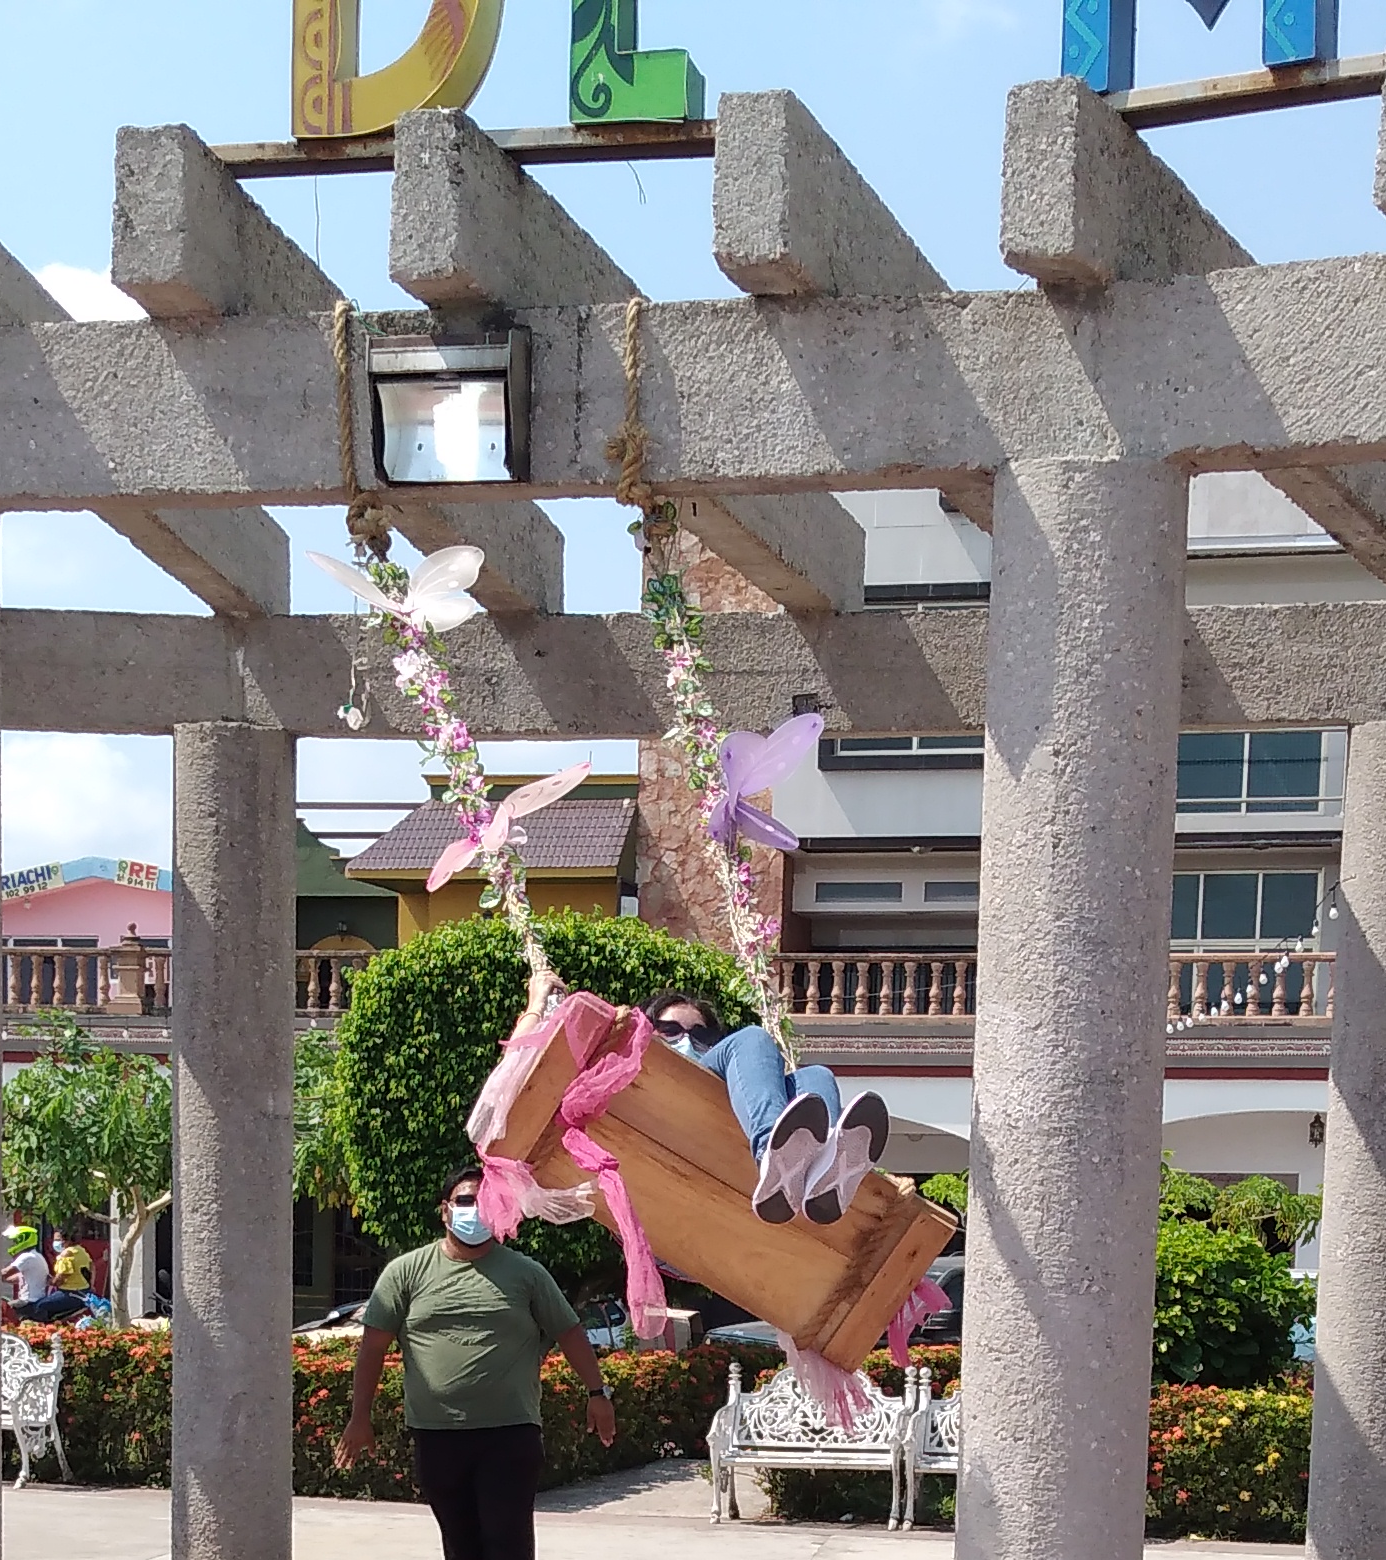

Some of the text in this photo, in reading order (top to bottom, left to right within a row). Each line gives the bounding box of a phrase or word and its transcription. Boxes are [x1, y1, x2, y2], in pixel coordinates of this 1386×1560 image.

[1, 865, 52, 890] RIACHI
[129, 861, 158, 881] RE
[5, 882, 48, 898] 102 99 12
